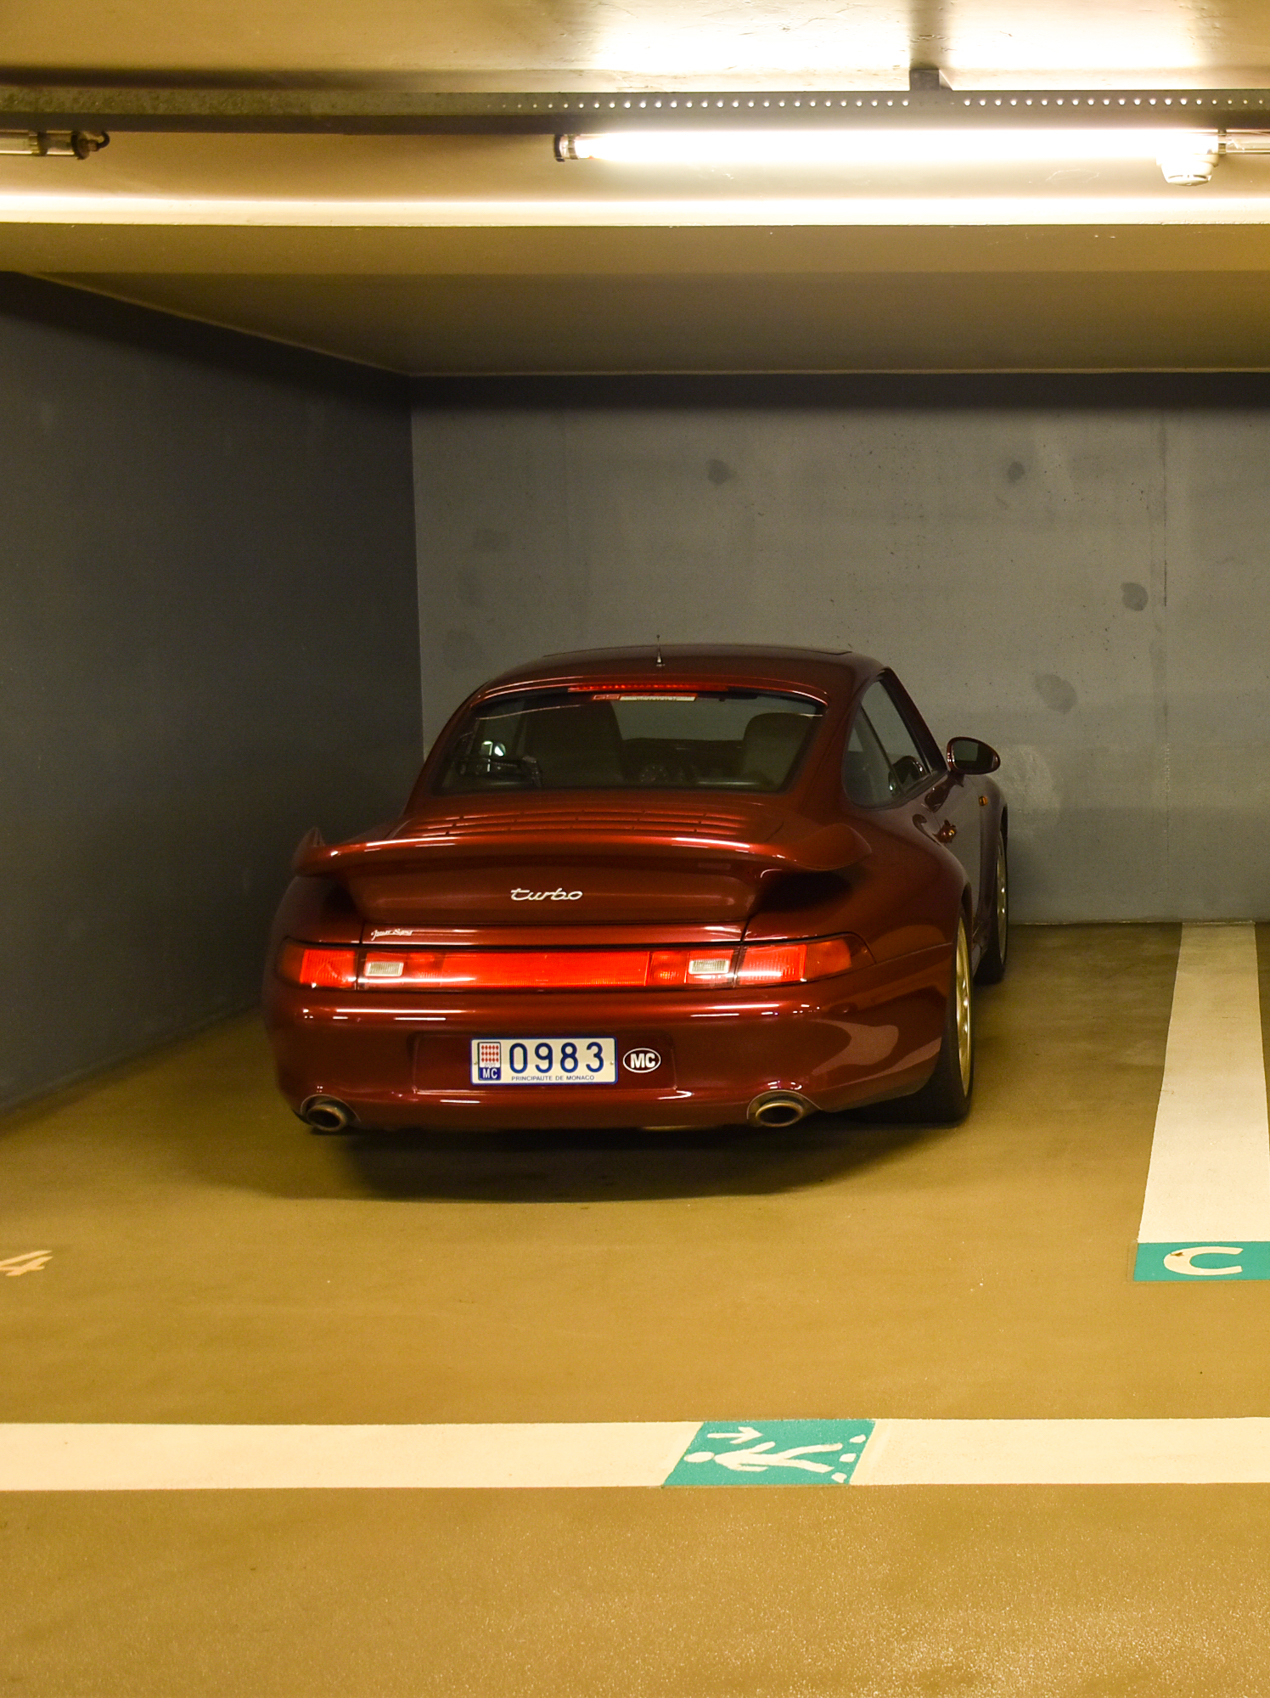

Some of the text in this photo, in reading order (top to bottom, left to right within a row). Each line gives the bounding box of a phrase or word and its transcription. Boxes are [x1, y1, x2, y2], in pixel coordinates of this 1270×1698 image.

[510, 887, 583, 901] turbo
[509, 1042, 604, 1074] 0983
[630, 1053, 656, 1069] MC
[482, 1068, 498, 1079] MC
[1163, 1245, 1244, 1277] C
